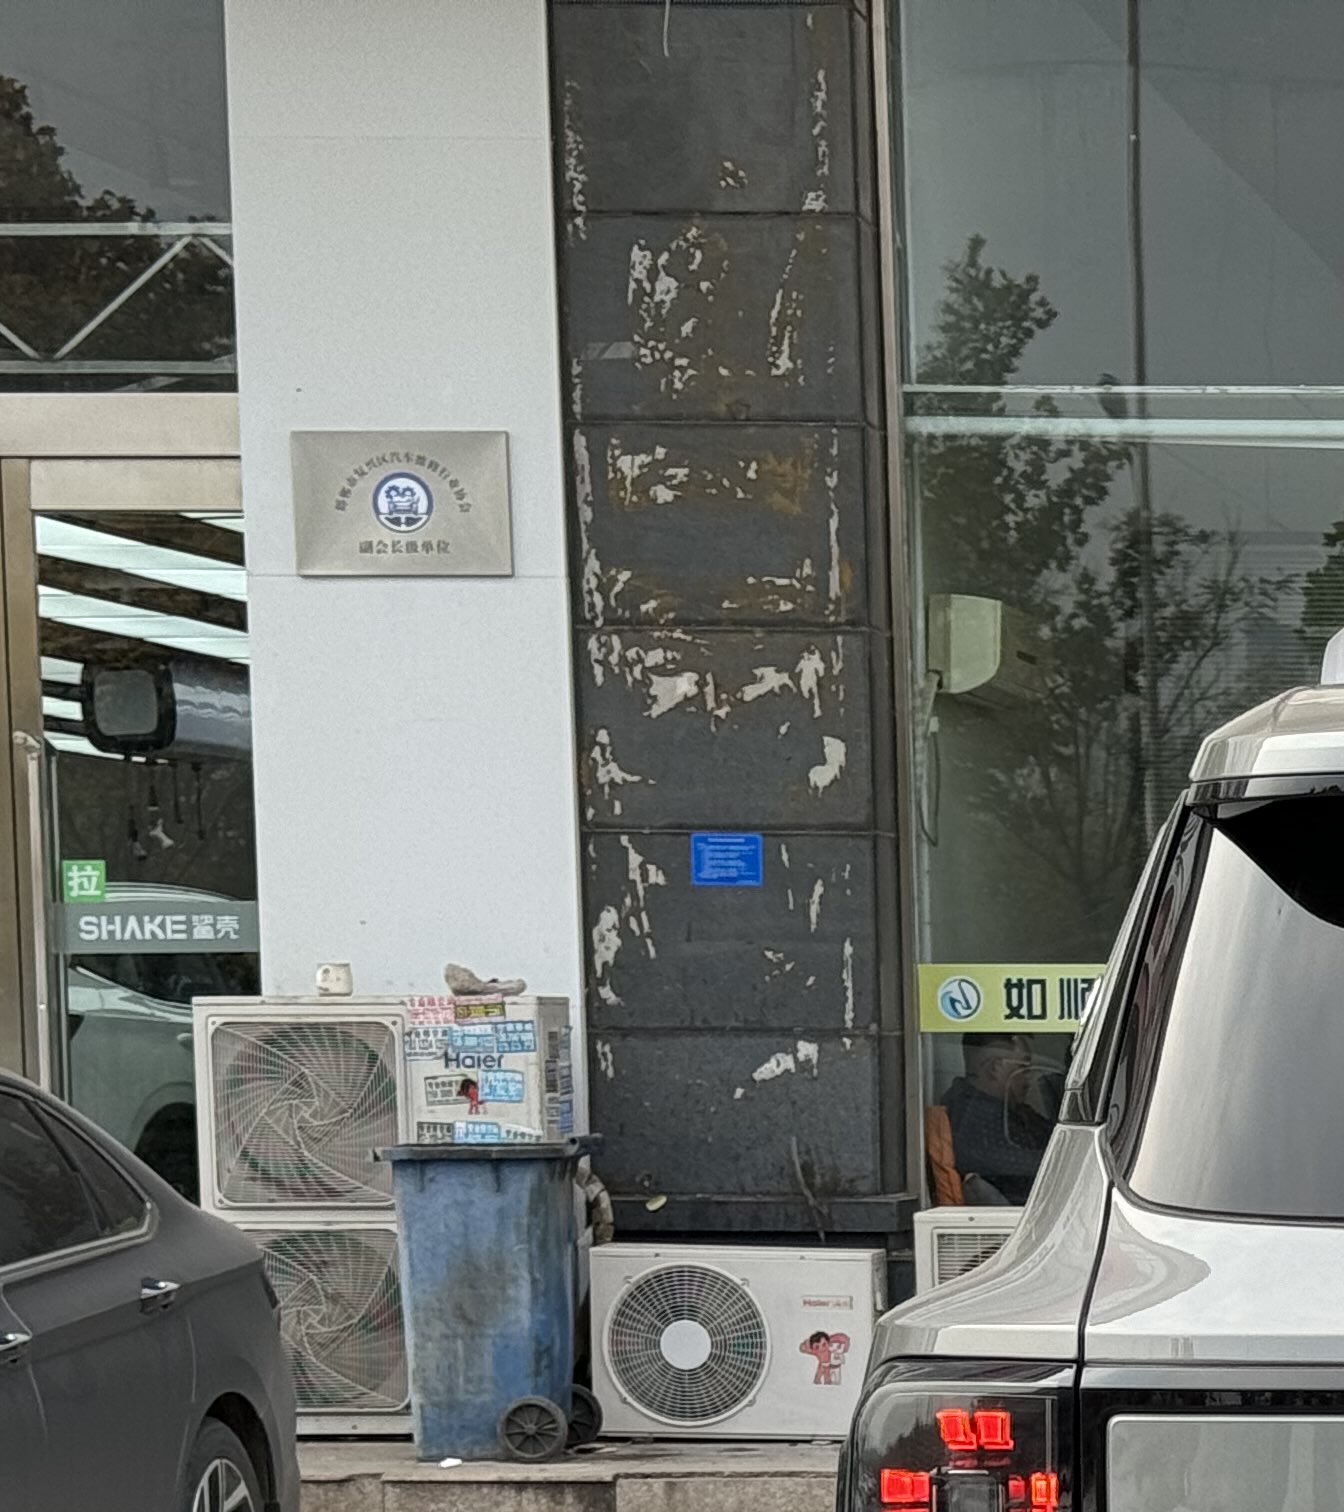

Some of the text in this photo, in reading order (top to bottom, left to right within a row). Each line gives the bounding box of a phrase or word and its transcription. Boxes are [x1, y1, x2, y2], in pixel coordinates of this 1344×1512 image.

[68, 865, 101, 897] 拉
[79, 915, 188, 941] SHAKE
[444, 1052, 504, 1069] Haier
